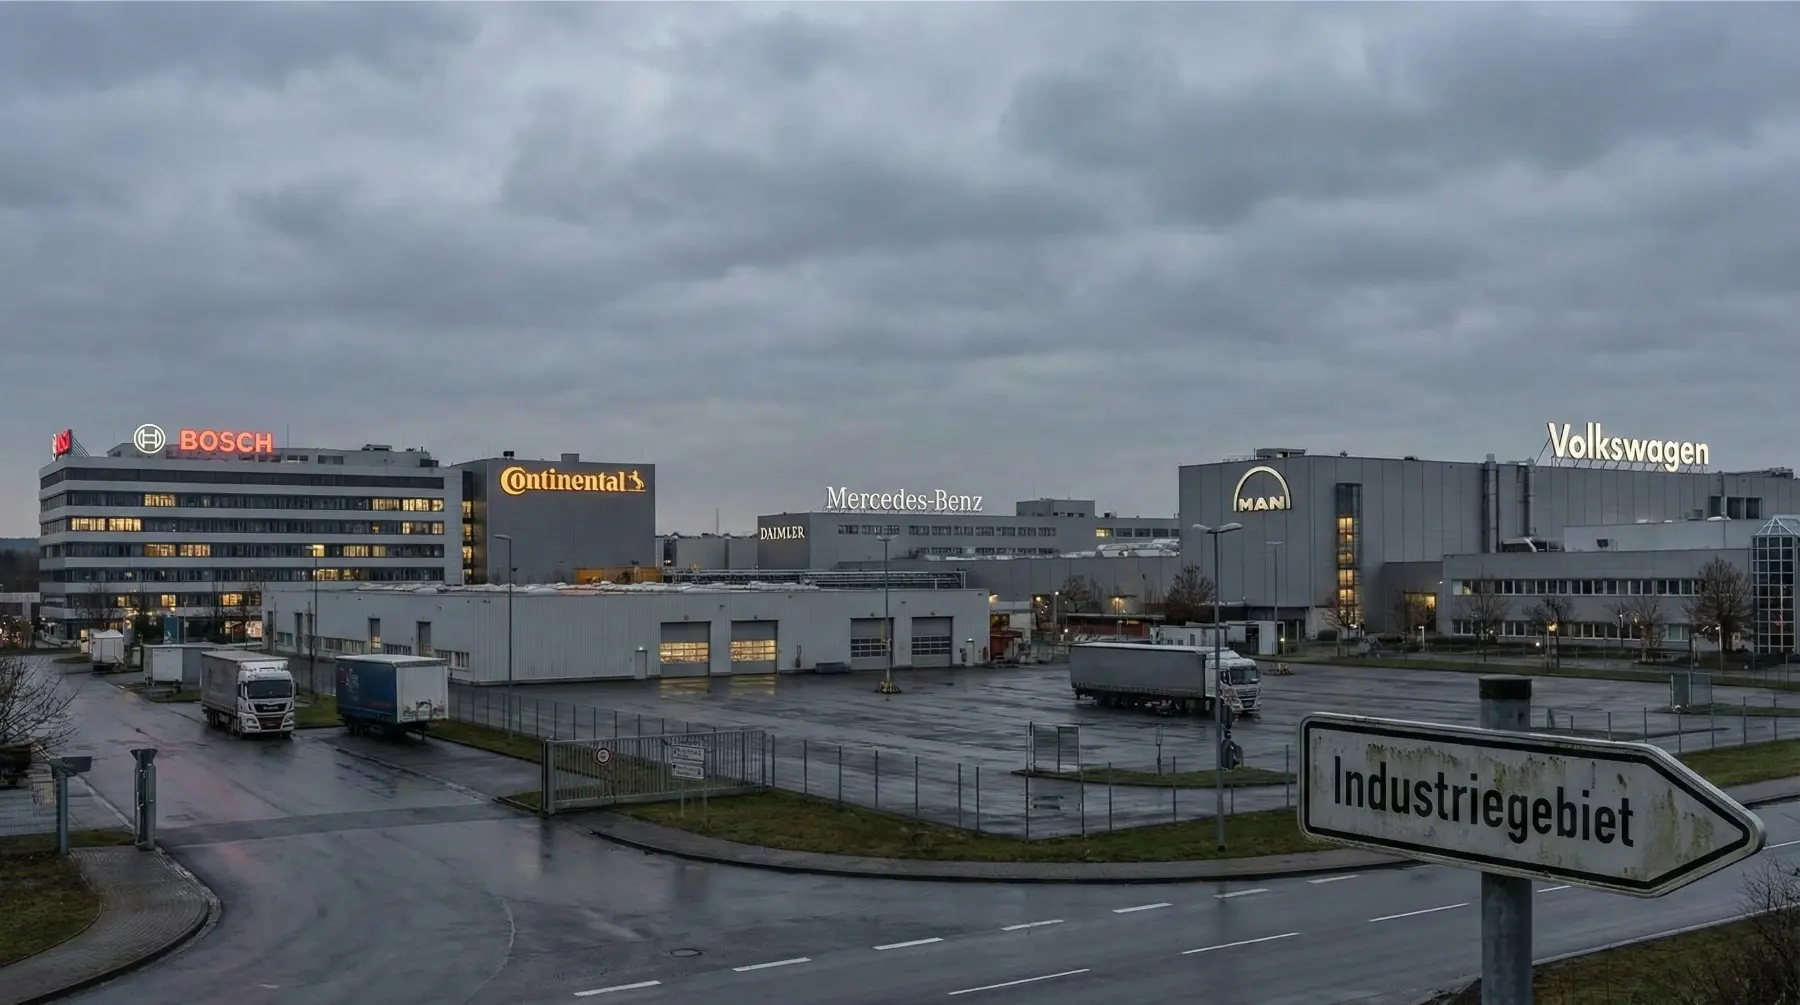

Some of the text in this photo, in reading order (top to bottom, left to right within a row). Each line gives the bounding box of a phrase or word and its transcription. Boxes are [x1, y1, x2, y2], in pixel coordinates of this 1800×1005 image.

[180, 429, 273, 453] BOSCH
[1547, 422, 1709, 472] Volkswagen
[501, 466, 626, 495] Continental
[826, 486, 983, 511] Mercedes-Benz
[1238, 496, 1285, 511] MAN
[760, 526, 805, 540] DAIMLER
[1334, 755, 1634, 848] Industriegebiet
